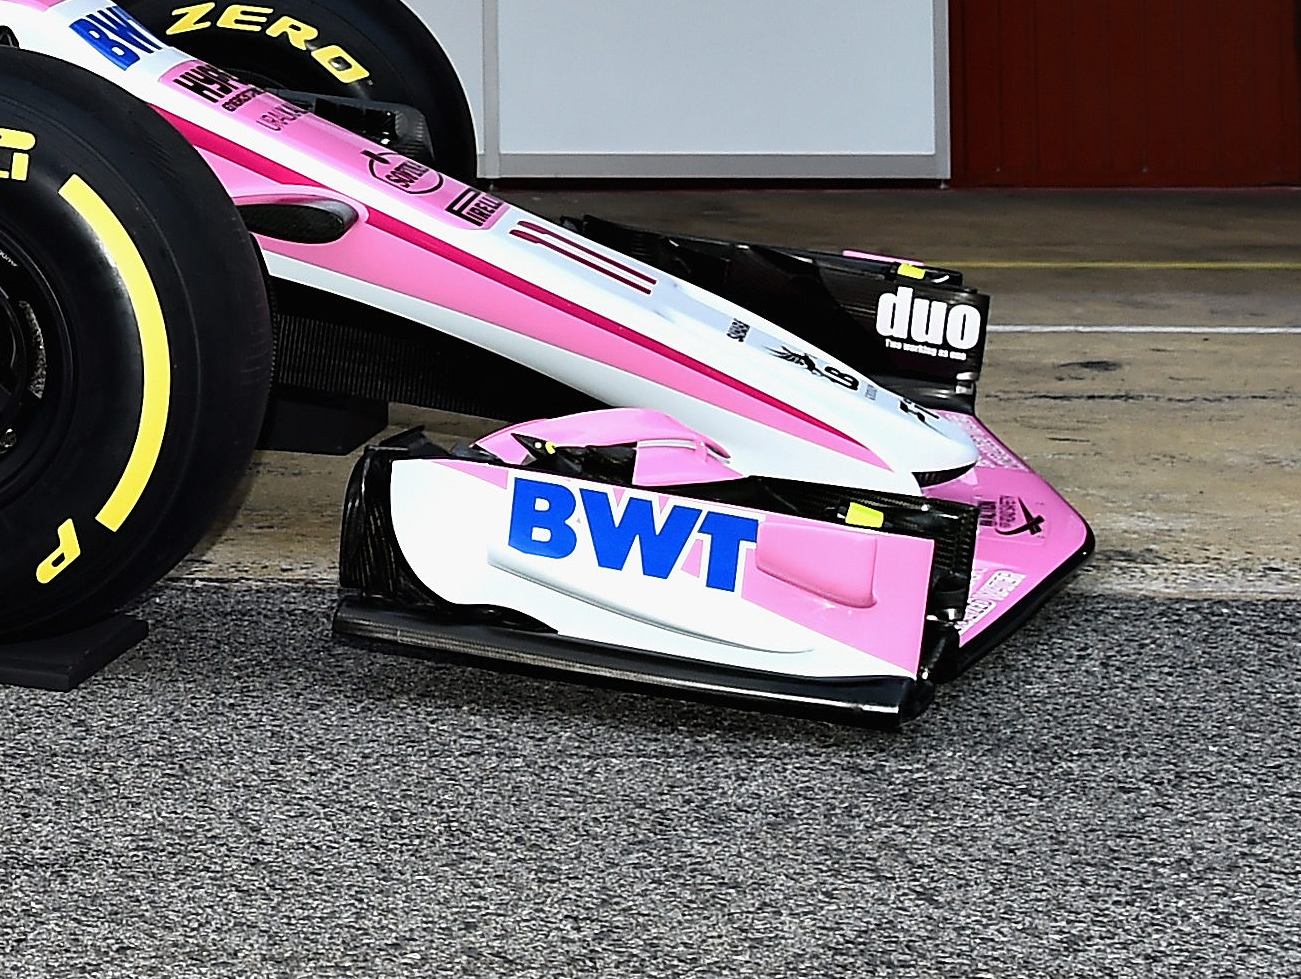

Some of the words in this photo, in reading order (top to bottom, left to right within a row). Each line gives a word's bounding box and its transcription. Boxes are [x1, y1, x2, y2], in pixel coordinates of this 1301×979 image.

[165, 1, 371, 84] ZERO
[875, 286, 981, 350] duo
[35, 518, 82, 585] P
[508, 478, 759, 592] BWT
